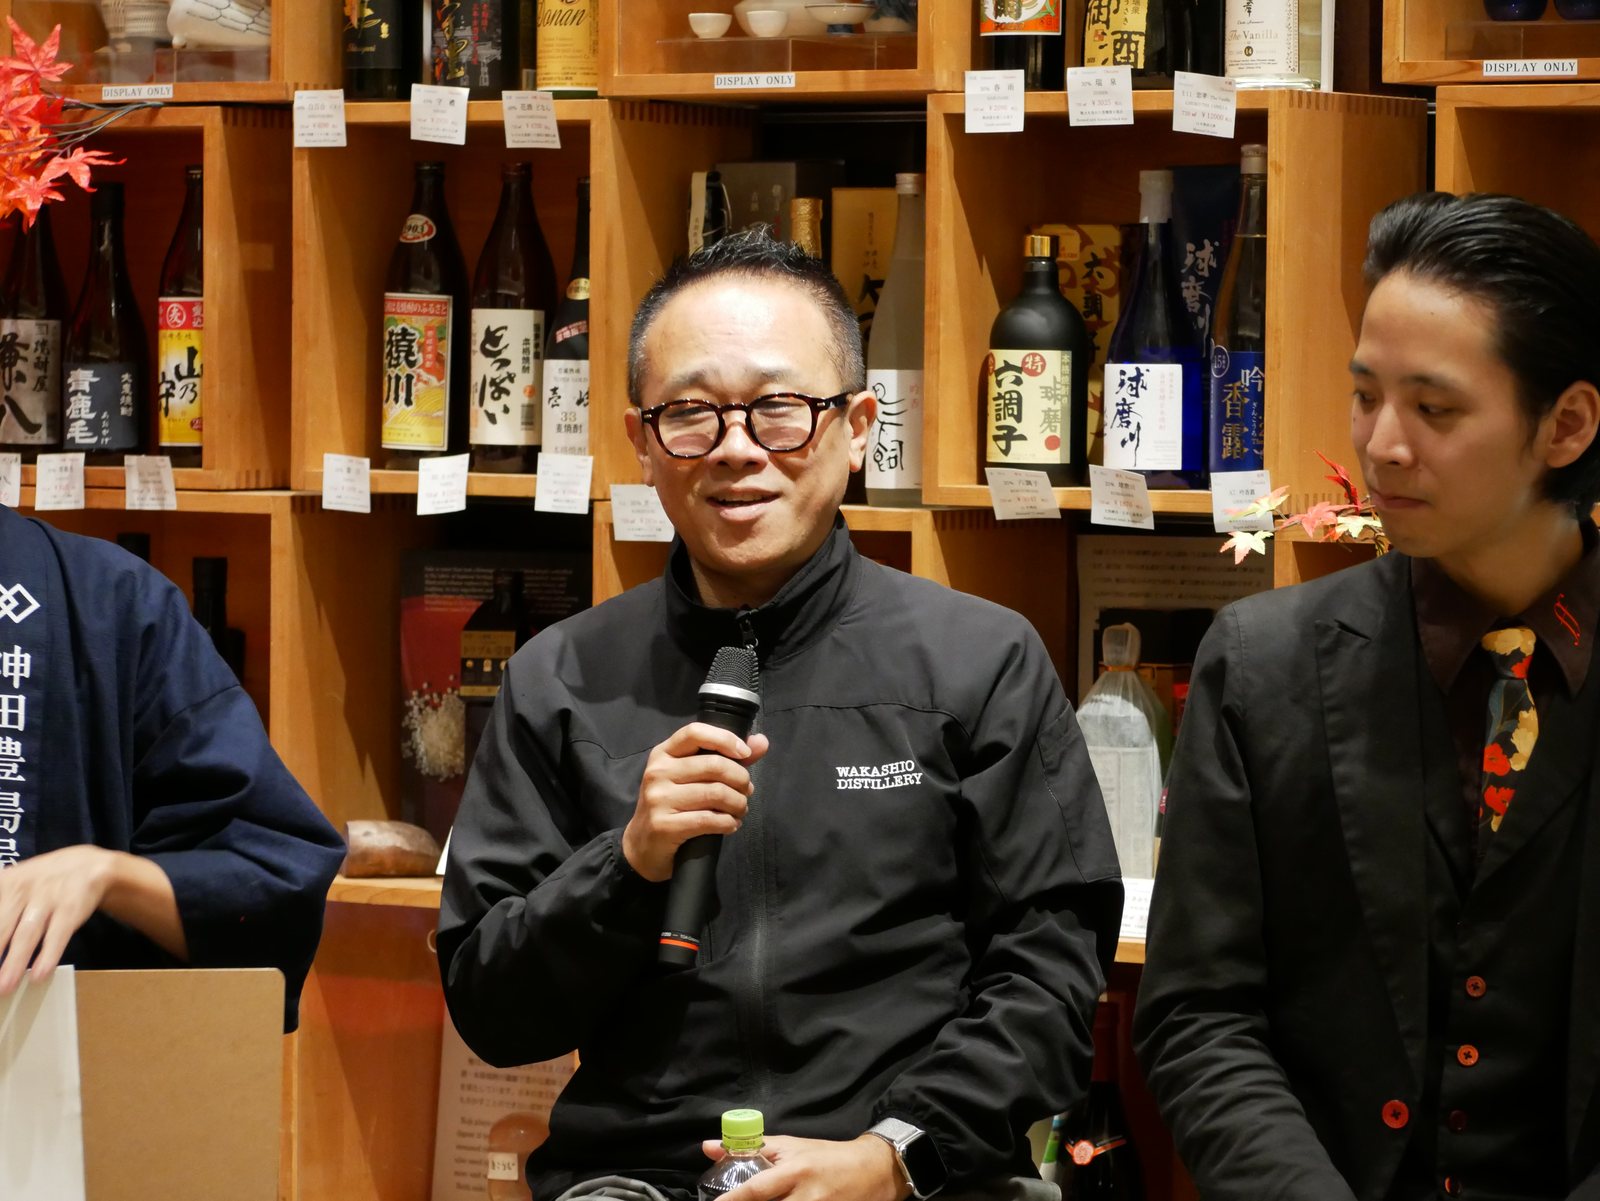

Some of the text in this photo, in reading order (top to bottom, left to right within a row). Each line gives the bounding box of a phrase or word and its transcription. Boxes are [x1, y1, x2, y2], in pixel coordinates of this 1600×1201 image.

[1228, 28, 1279, 41] The Vanilla
[1484, 61, 1576, 73] DISPLAY ONLY
[714, 74, 795, 86] DISPLAY ONLY
[103, 85, 173, 97] DISPLAY ONLY
[385, 326, 418, 407] 猿川
[1023, 355, 1043, 373] 特
[66, 368, 100, 444] 青鹿毛
[993, 359, 1028, 458] 六調子
[1039, 376, 1062, 434] 球磨
[560, 411, 577, 422] 33
[1109, 366, 1150, 467] 球磨川
[836, 760, 915, 778] WAKASHIO
[837, 773, 923, 790] DISTILLERY
